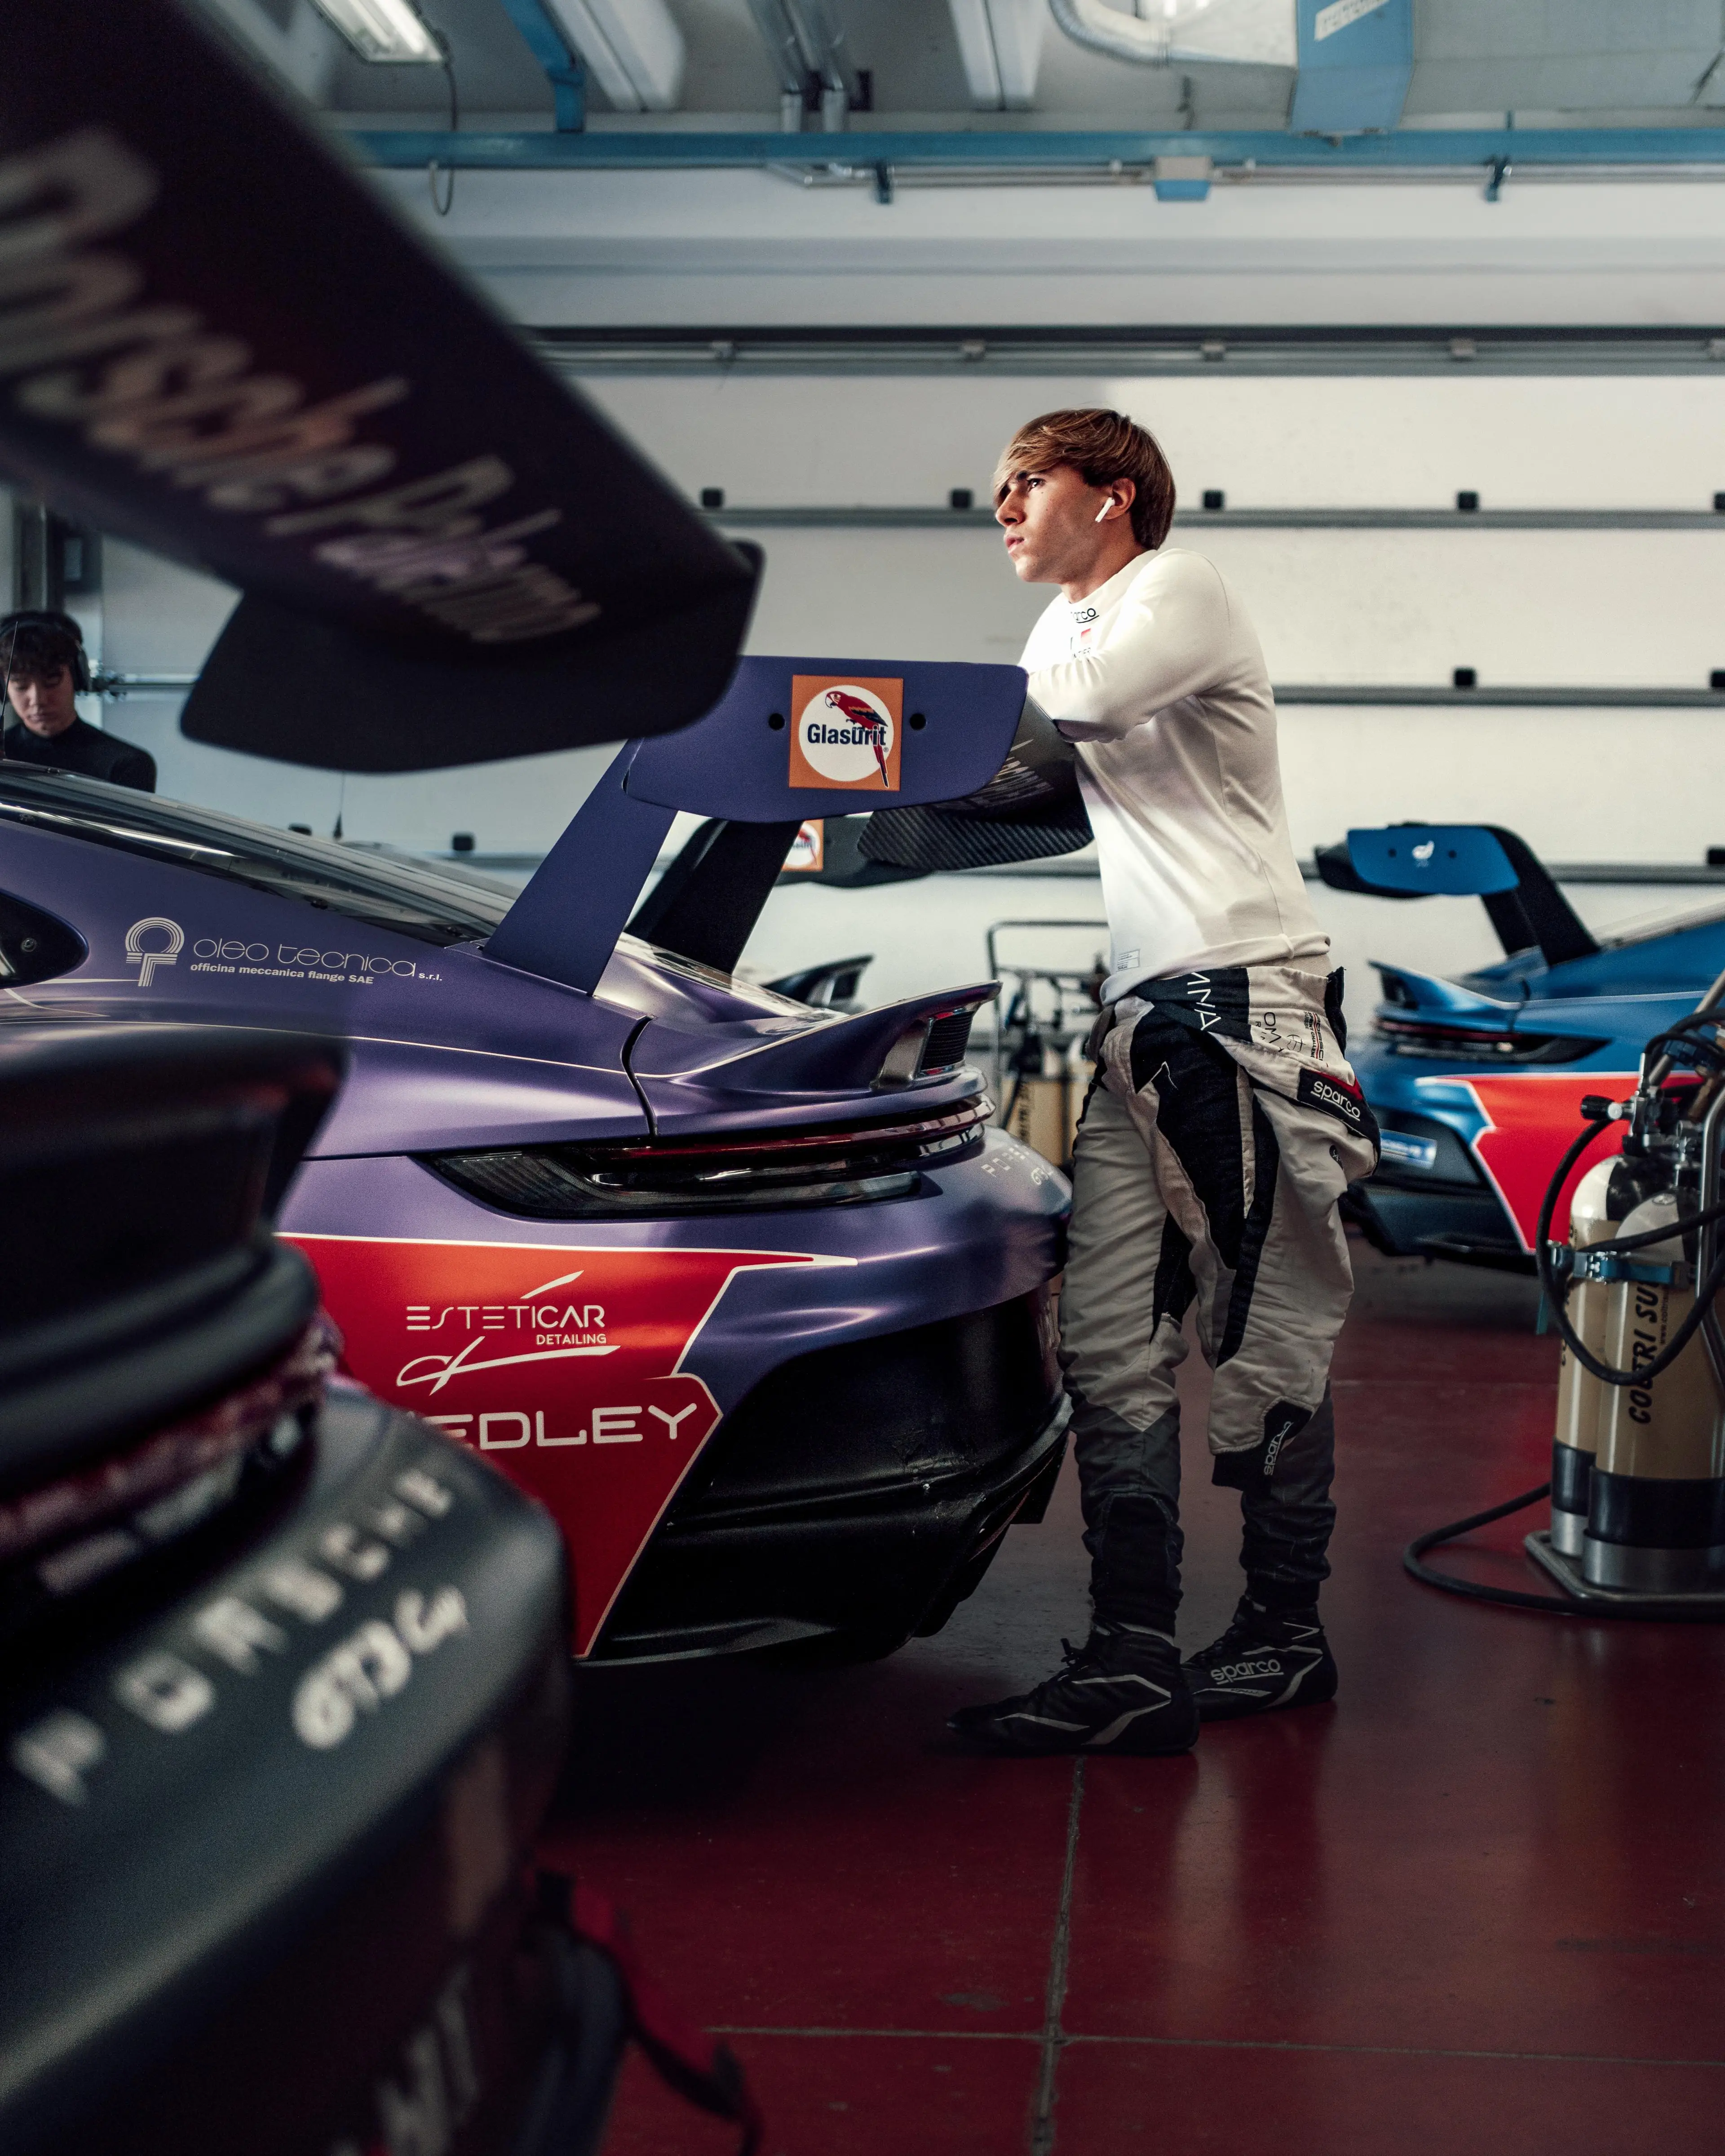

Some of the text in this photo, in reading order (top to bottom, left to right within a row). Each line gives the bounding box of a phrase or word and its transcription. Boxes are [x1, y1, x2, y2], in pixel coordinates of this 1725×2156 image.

[807, 723, 886, 746] Glasurit
[193, 939, 442, 981] oleo tecnica s.r.l.
[190, 963, 235, 974] officina
[239, 967, 305, 978] meccanica
[349, 975, 373, 984] SAE
[1310, 1080, 1361, 1121] sparco
[407, 1304, 606, 1330] ESTETICAR
[536, 1333, 606, 1345] DETAILING
[409, 1403, 698, 1450] EDLEY
[1210, 1658, 1285, 1685] sparco
